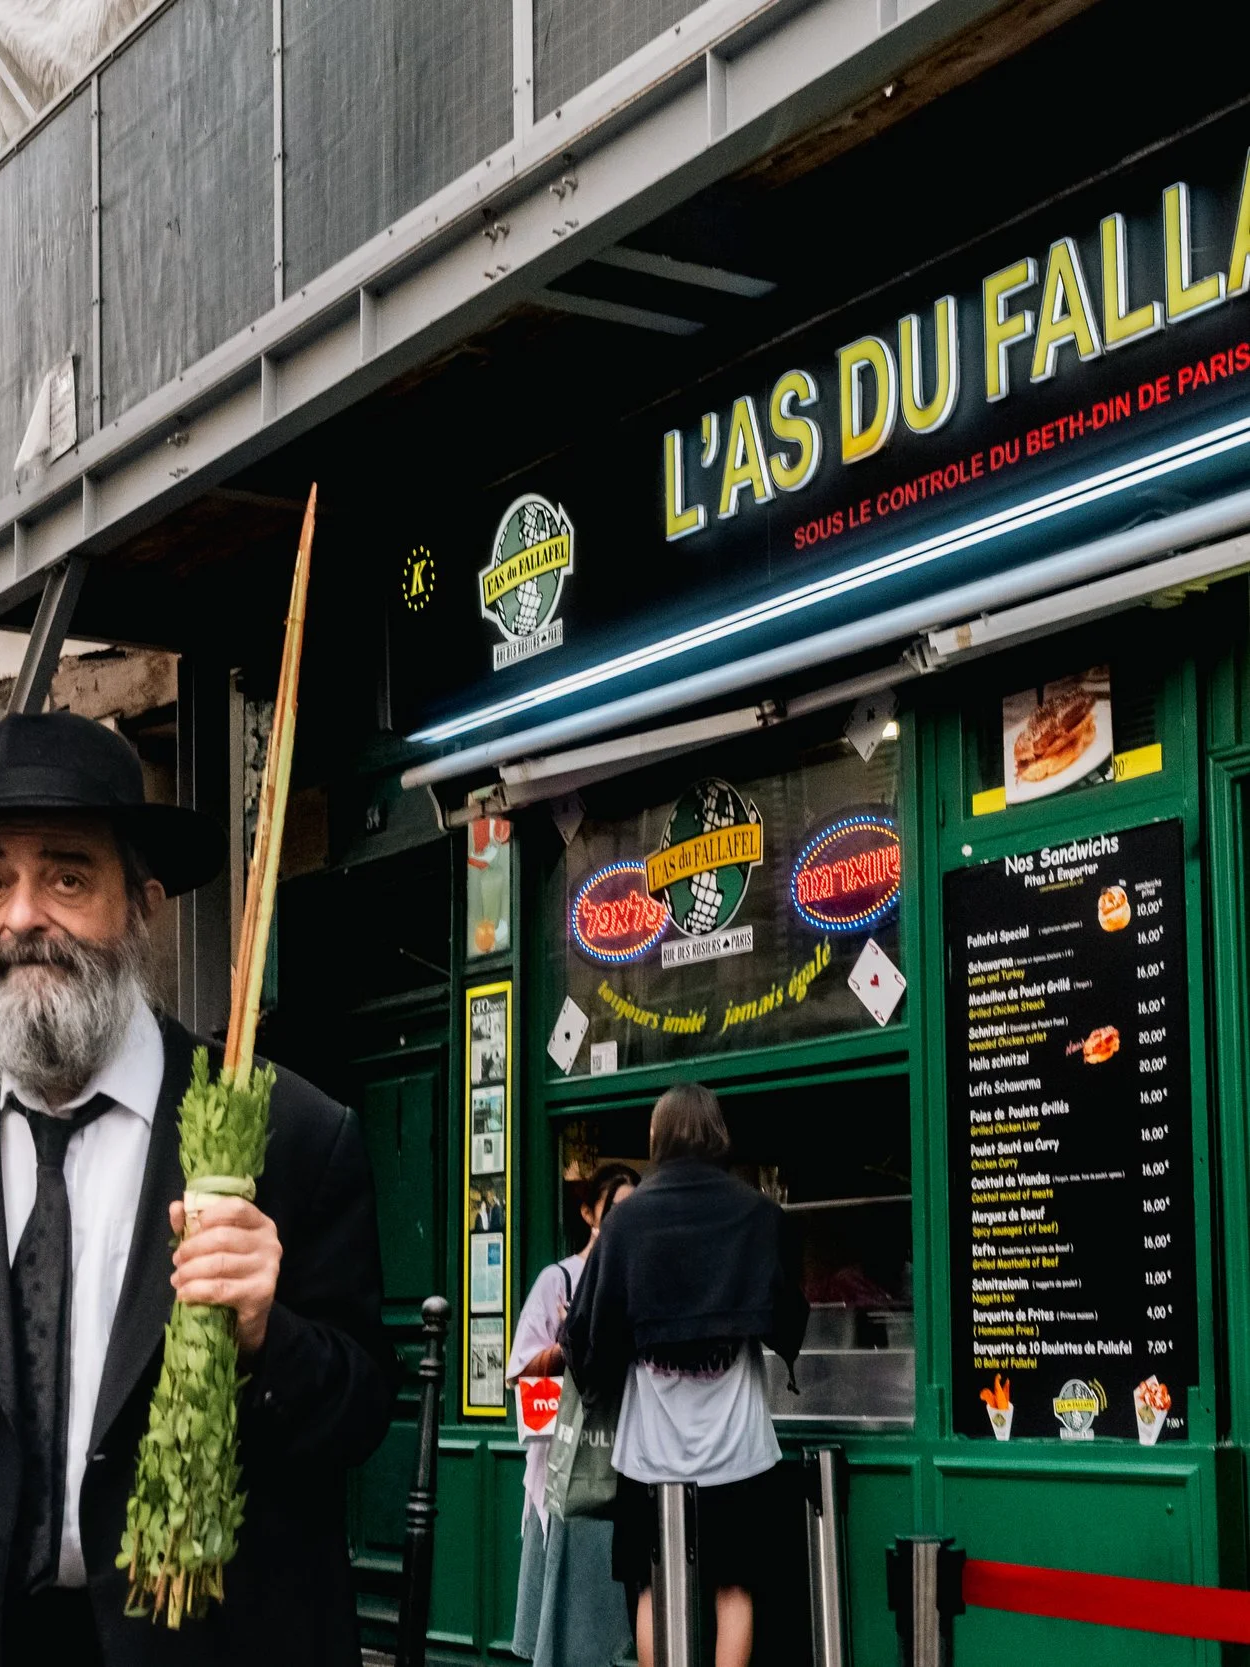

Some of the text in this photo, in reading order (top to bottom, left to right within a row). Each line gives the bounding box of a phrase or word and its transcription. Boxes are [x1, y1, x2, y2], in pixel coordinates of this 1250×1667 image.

[664, 369, 821, 543] L'AS
[837, 294, 960, 465] DU
[793, 342, 1250, 551] SOUS LE CONTROLE DU BETH-DIN DE PARIS
[410, 559, 427, 597] K
[487, 541, 567, 597] L'AS du FALLAFEL
[651, 831, 758, 889] L'AS du FALLAFEL
[1005, 835, 1120, 877] Nos Sandwichs
[1024, 873, 1046, 888] Pitas
[1048, 869, 1055, 883] à
[1057, 863, 1099, 882] Emporter
[692, 938, 721, 957] ROSIERS
[731, 932, 752, 949] PARIS
[967, 931, 998, 949] Fallafel
[999, 924, 1030, 945] Special
[968, 957, 1014, 975] Schawarma
[968, 968, 1025, 987] Lamb and Turkey
[968, 989, 1007, 1007] Medaillon
[1007, 986, 1018, 1000] de
[1019, 982, 1046, 998] Poulet
[597, 979, 660, 1030] toujours
[663, 1005, 707, 1033] imité
[720, 983, 784, 1036] jamais
[968, 1005, 991, 1020] Grilled
[992, 1003, 1019, 1016] Chicken
[968, 1021, 1007, 1040] Schnitzel
[997, 1034, 1025, 1048] Chicken
[991, 1049, 1030, 1067] schnitzel
[969, 1077, 1041, 1098] Laffa Schawarma
[994, 1107, 1005, 1121] de
[1008, 1104, 1039, 1120] Poulets
[970, 1120, 1041, 1137] Grilled Chicken Liver
[970, 1137, 1060, 1157] Poulet Sauté au Curry
[971, 1157, 1018, 1171] Chicken Curry
[971, 1174, 1004, 1190] Cocktail
[1005, 1172, 1016, 1187] de
[1017, 1171, 1051, 1187] Viandes
[971, 1187, 1054, 1203] Cocktail mixed of meats
[972, 1205, 1046, 1226] Merguez de Boeuf
[972, 1226, 991, 1239] Spicy
[1028, 1222, 1037, 1235] of
[972, 1242, 996, 1257] Kefta
[972, 1254, 1059, 1271] Grilled Meatballs of Beef
[972, 1292, 1016, 1306] Nuggets box
[973, 1308, 1014, 1325] Barquette
[1015, 1307, 1027, 1322] de
[1027, 1307, 1055, 1322] Frites
[978, 1325, 1014, 1336] Homemade
[973, 1339, 1132, 1359] Barquette de 10 Boulettes de Fallafel
[974, 1356, 1038, 1369] 10 Balls of Fallafel
